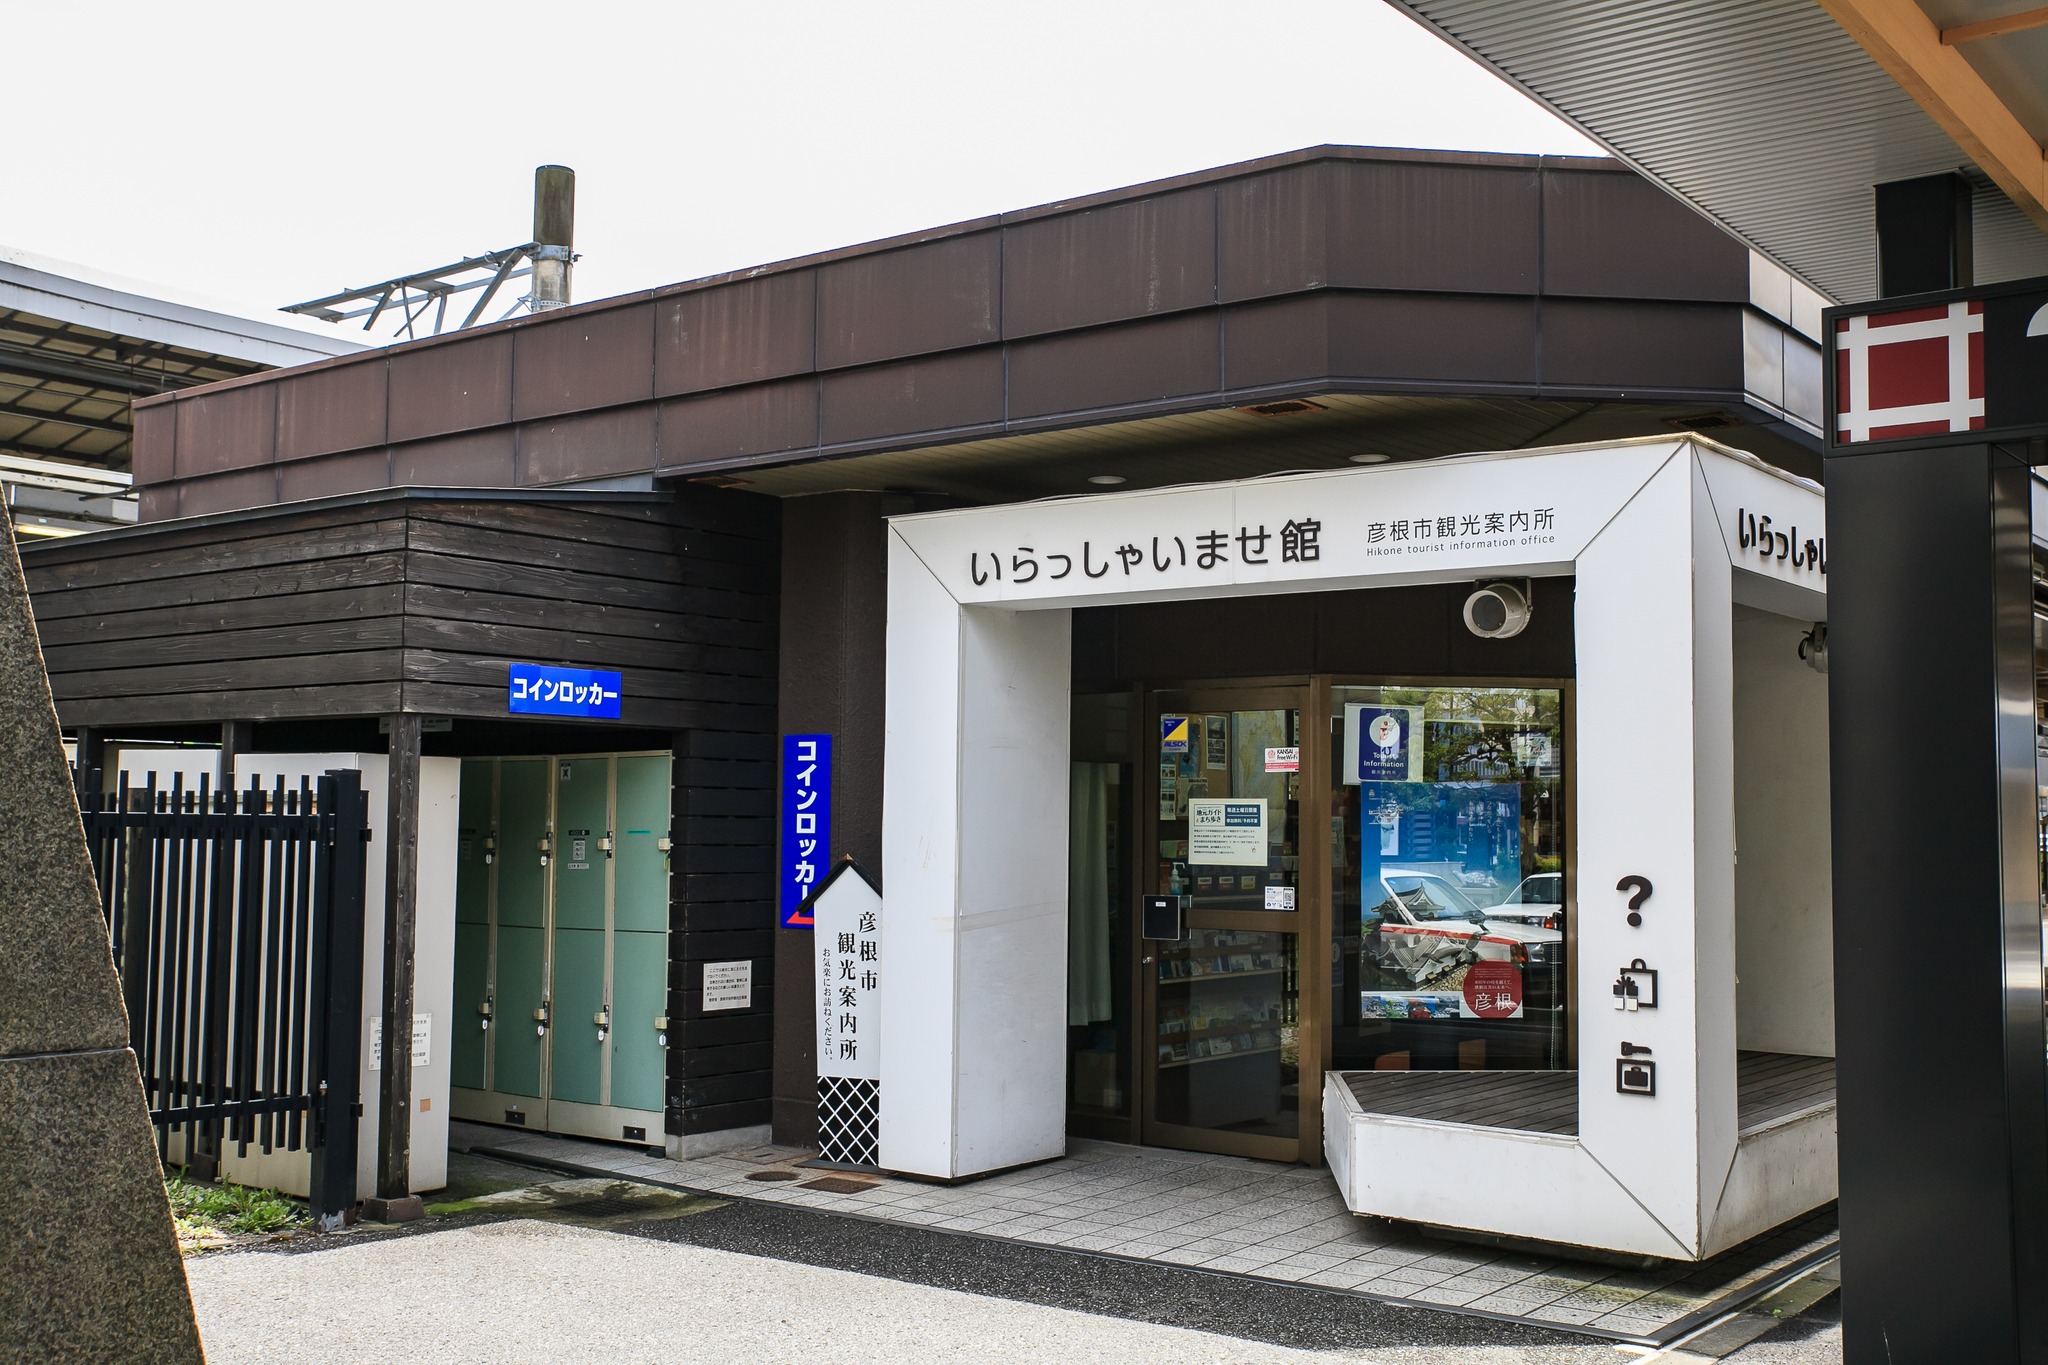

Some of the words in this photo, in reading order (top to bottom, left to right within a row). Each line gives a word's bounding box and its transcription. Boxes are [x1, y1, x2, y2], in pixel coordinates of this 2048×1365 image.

[1366, 546, 1402, 557] Hikone
[1407, 543, 1445, 554] tourist
[1449, 538, 1516, 551] information
[1521, 535, 1555, 546] office
[1367, 507, 1555, 544] 彦根市観光案内所
[970, 518, 1322, 586] いらっしゃいませ館
[513, 678, 618, 706] コインロッカー
[1363, 760, 1404, 768] Information
[794, 741, 818, 902] コインロッカー
[858, 911, 878, 992] 彦根市
[822, 948, 833, 1061] お気楽にお訪ねください。
[838, 932, 857, 1061] 観光案内所
[1474, 992, 1513, 1011] 彦根
